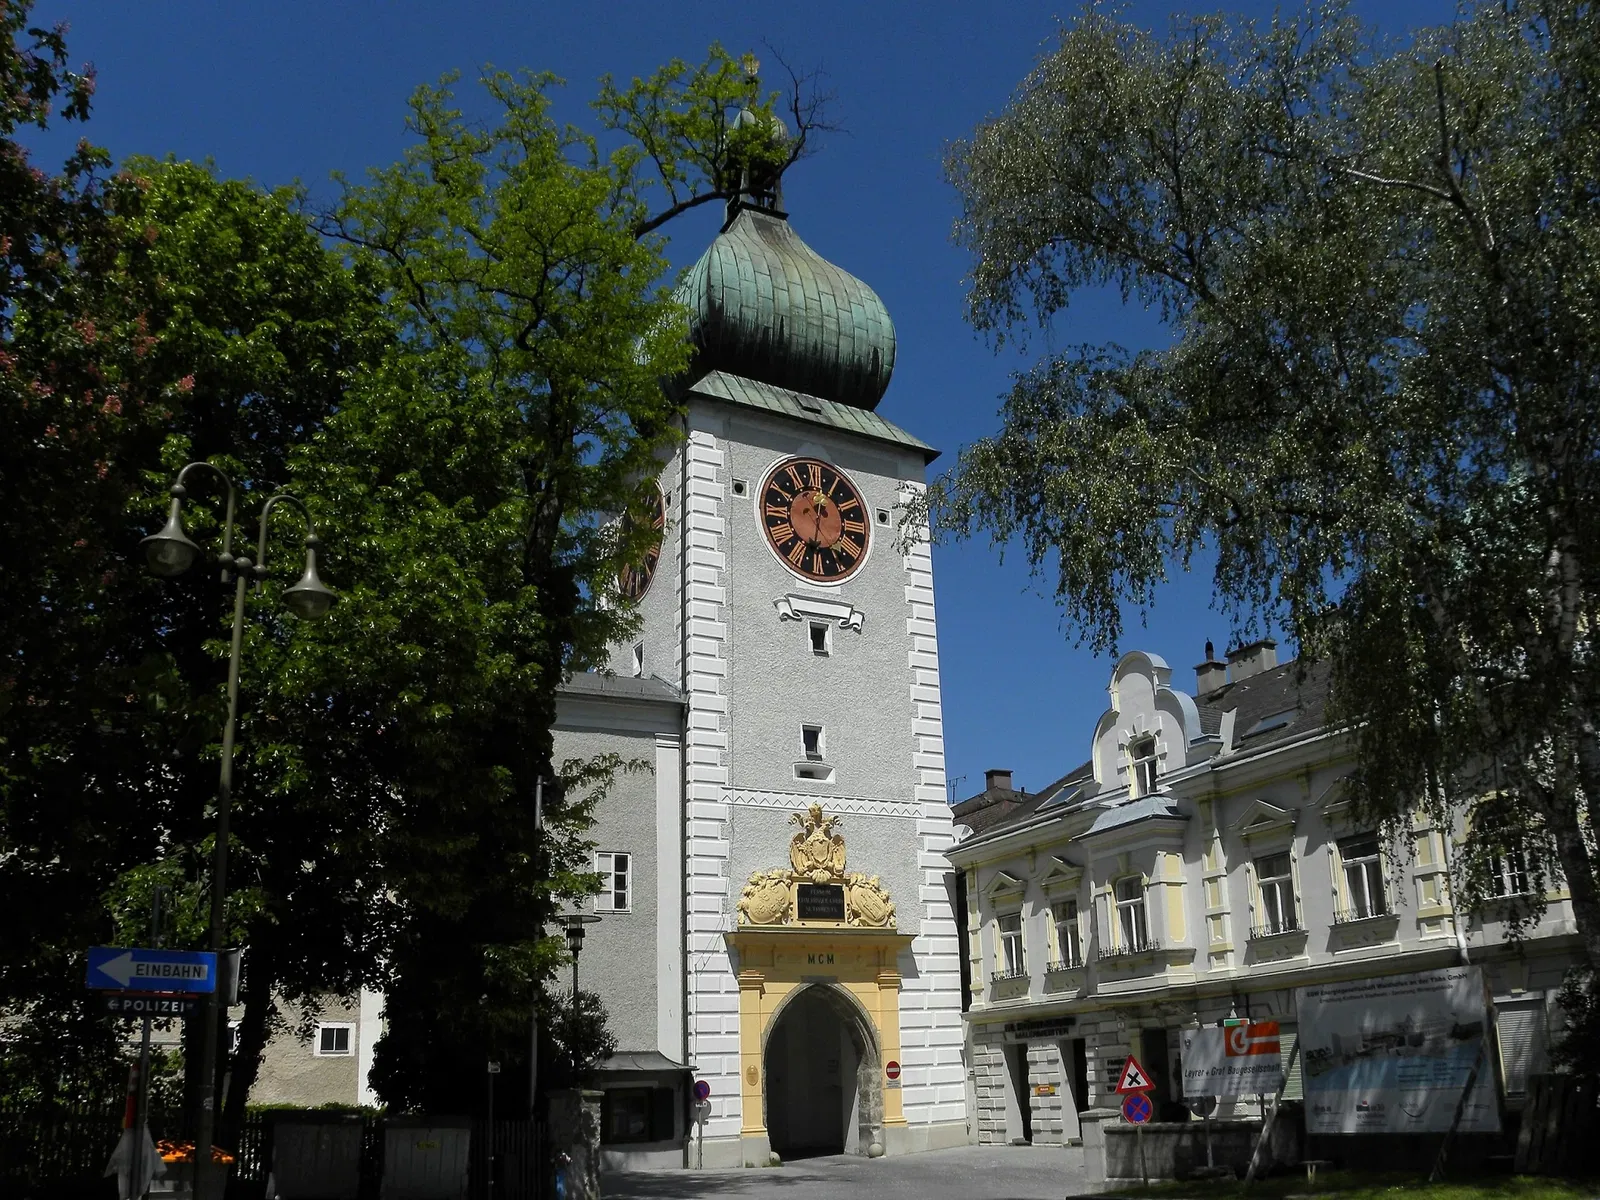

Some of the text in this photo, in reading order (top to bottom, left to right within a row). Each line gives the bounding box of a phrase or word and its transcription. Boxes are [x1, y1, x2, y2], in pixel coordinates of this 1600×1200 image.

[785, 466, 804, 490] XI
[807, 464, 822, 489] XII
[770, 481, 792, 501] X
[766, 503, 788, 518] IX
[839, 498, 859, 512] II
[844, 520, 865, 534] III
[813, 553, 824, 575] VI
[808, 953, 835, 965] MCM
[136, 963, 203, 979] EINBAHN
[123, 999, 185, 1013] POLIZEI
[1184, 1068, 1204, 1079] Leyrer
[1211, 1066, 1226, 1076] Graf
[1227, 1063, 1281, 1076] Baugesellschaft
